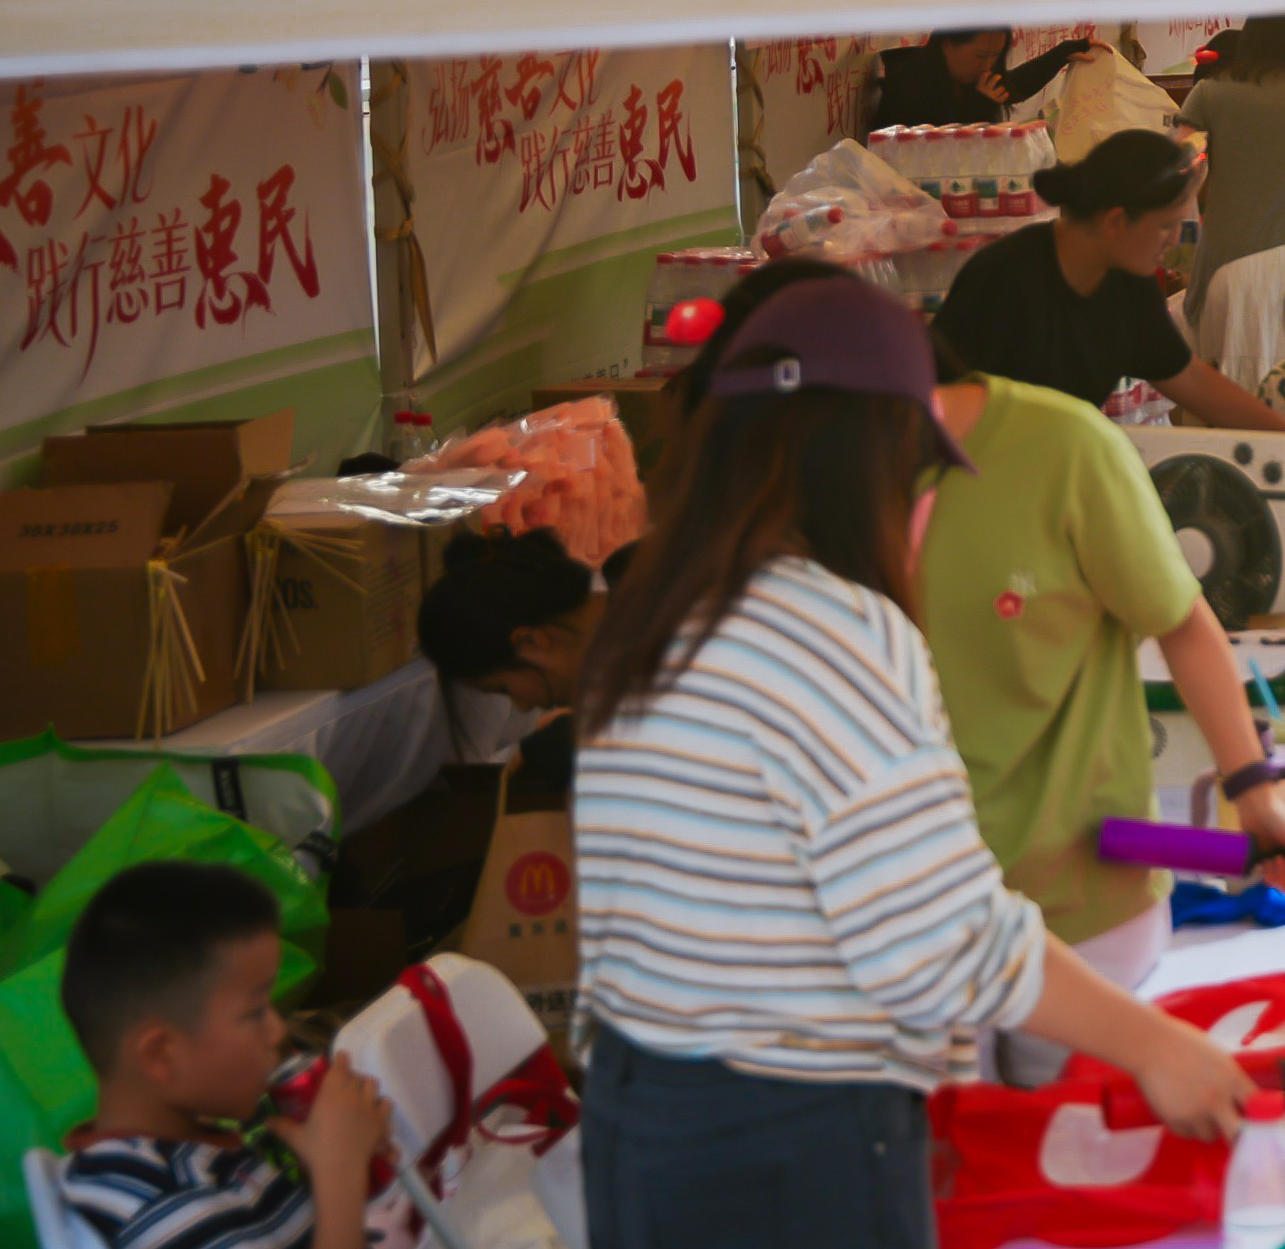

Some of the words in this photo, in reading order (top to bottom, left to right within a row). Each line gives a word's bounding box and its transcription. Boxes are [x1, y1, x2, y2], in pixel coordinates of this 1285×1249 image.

[423, 49, 602, 166] 弘扬慈善文化
[518, 78, 698, 214] 践行慈善惠民
[20, 163, 322, 388] 践行慈善惠民
